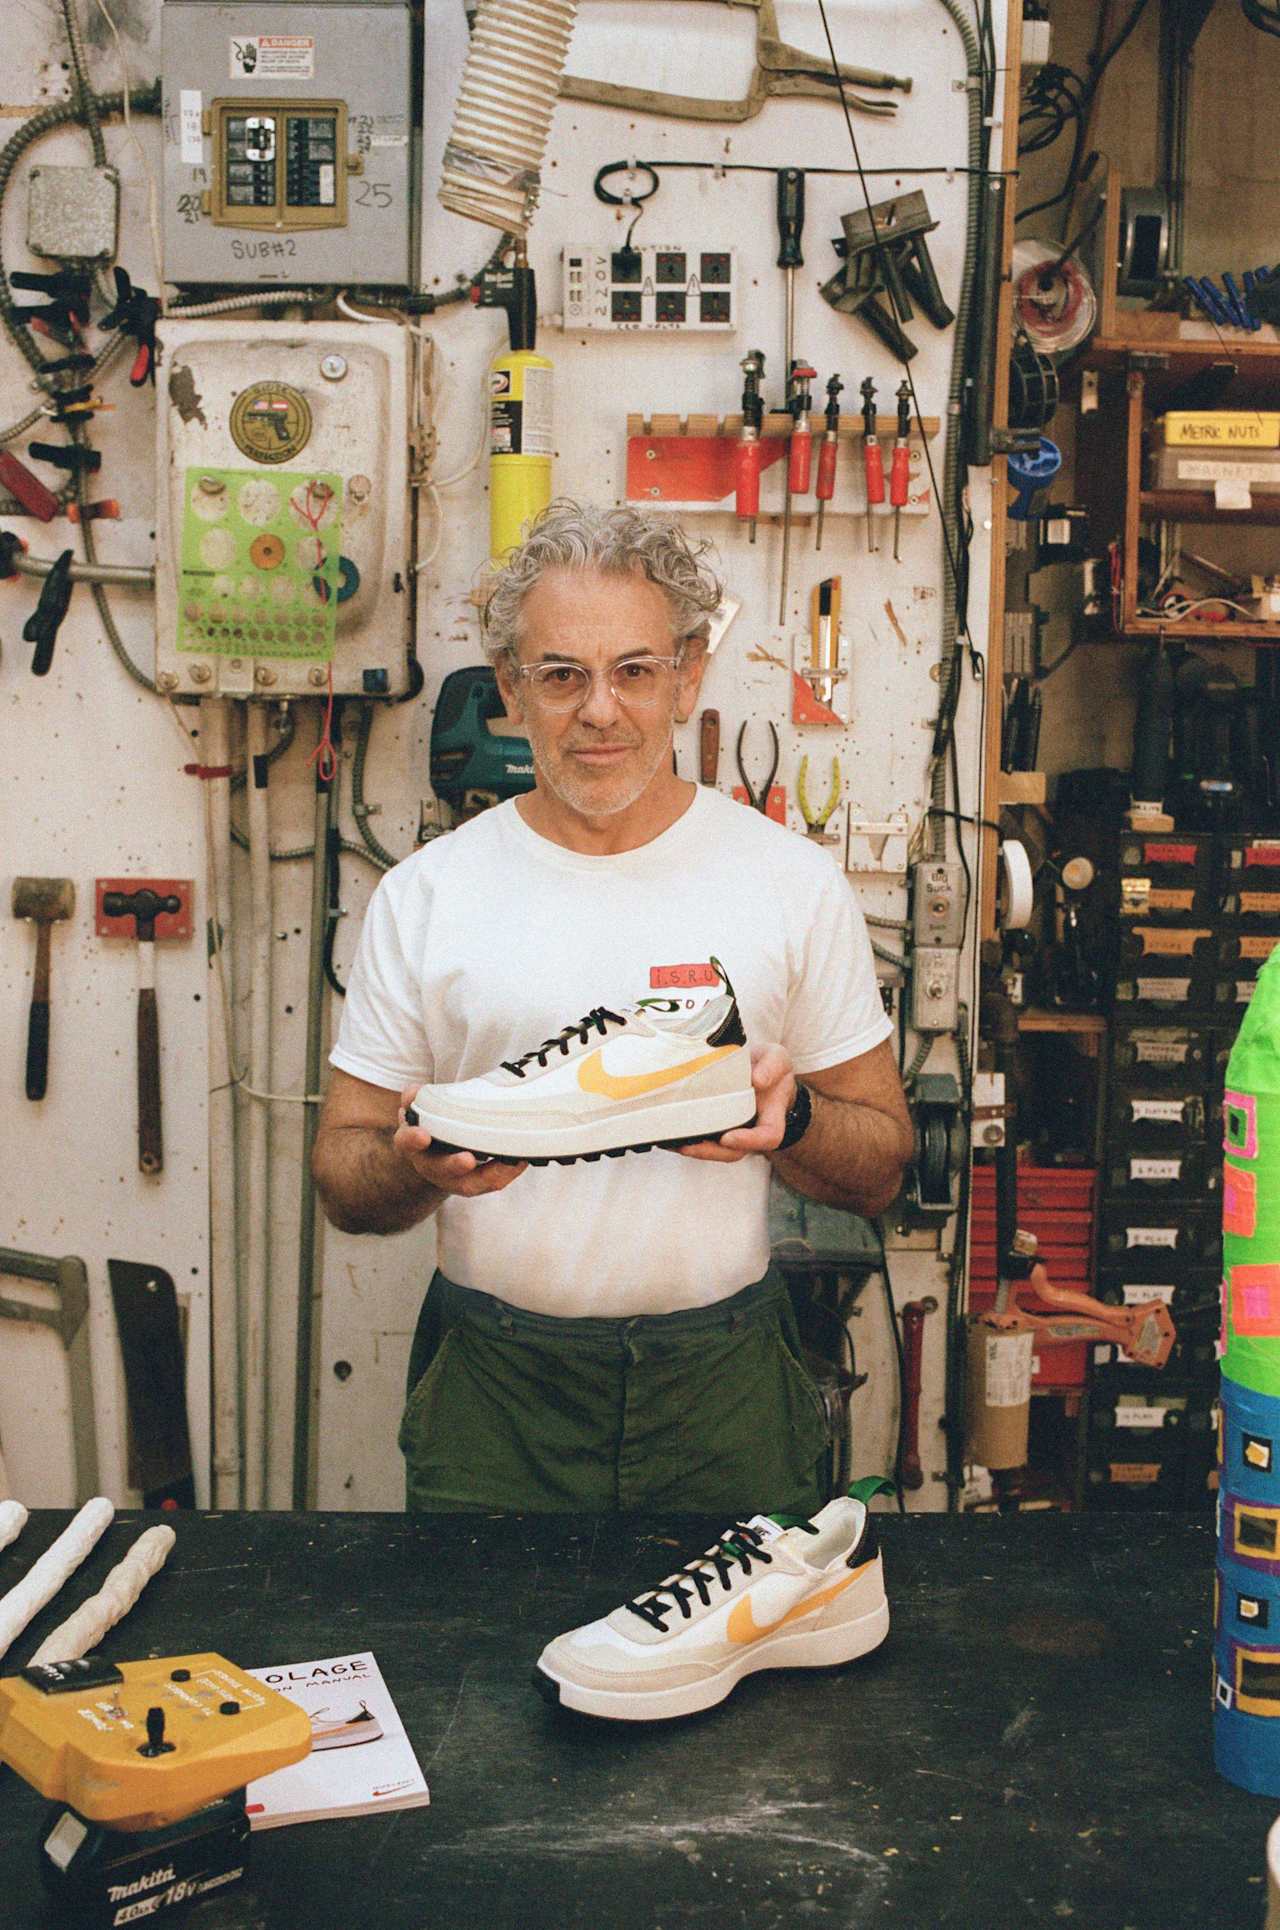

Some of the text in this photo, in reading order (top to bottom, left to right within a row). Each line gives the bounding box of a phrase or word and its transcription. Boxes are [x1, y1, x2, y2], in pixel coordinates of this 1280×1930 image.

[192, 167, 207, 184] 19
[177, 193, 201, 212] 20
[355, 180, 393, 208] 25
[231, 239, 297, 260] SUB#2
[631, 244, 682, 252] AUTION
[263, 1660, 369, 1684] OLAGE
[107, 1863, 177, 1903] makita
